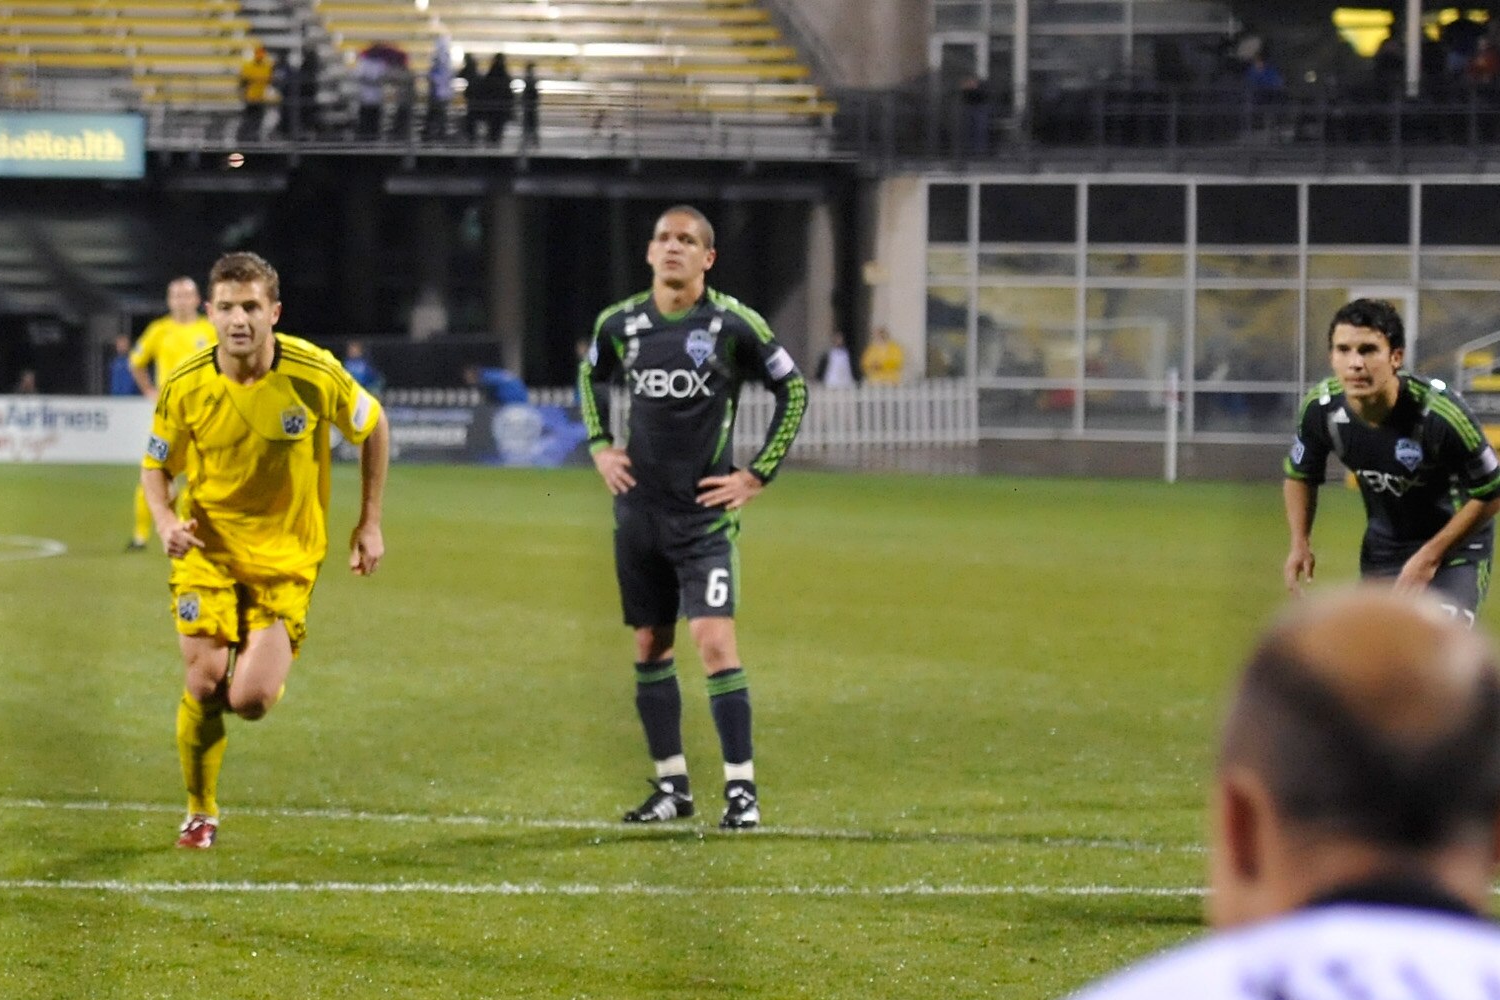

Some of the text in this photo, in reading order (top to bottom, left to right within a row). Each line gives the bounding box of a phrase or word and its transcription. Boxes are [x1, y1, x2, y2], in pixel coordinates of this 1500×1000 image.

[631, 368, 713, 399] XBOX
[1356, 469, 1426, 497] BOX
[705, 567, 730, 608] 6
